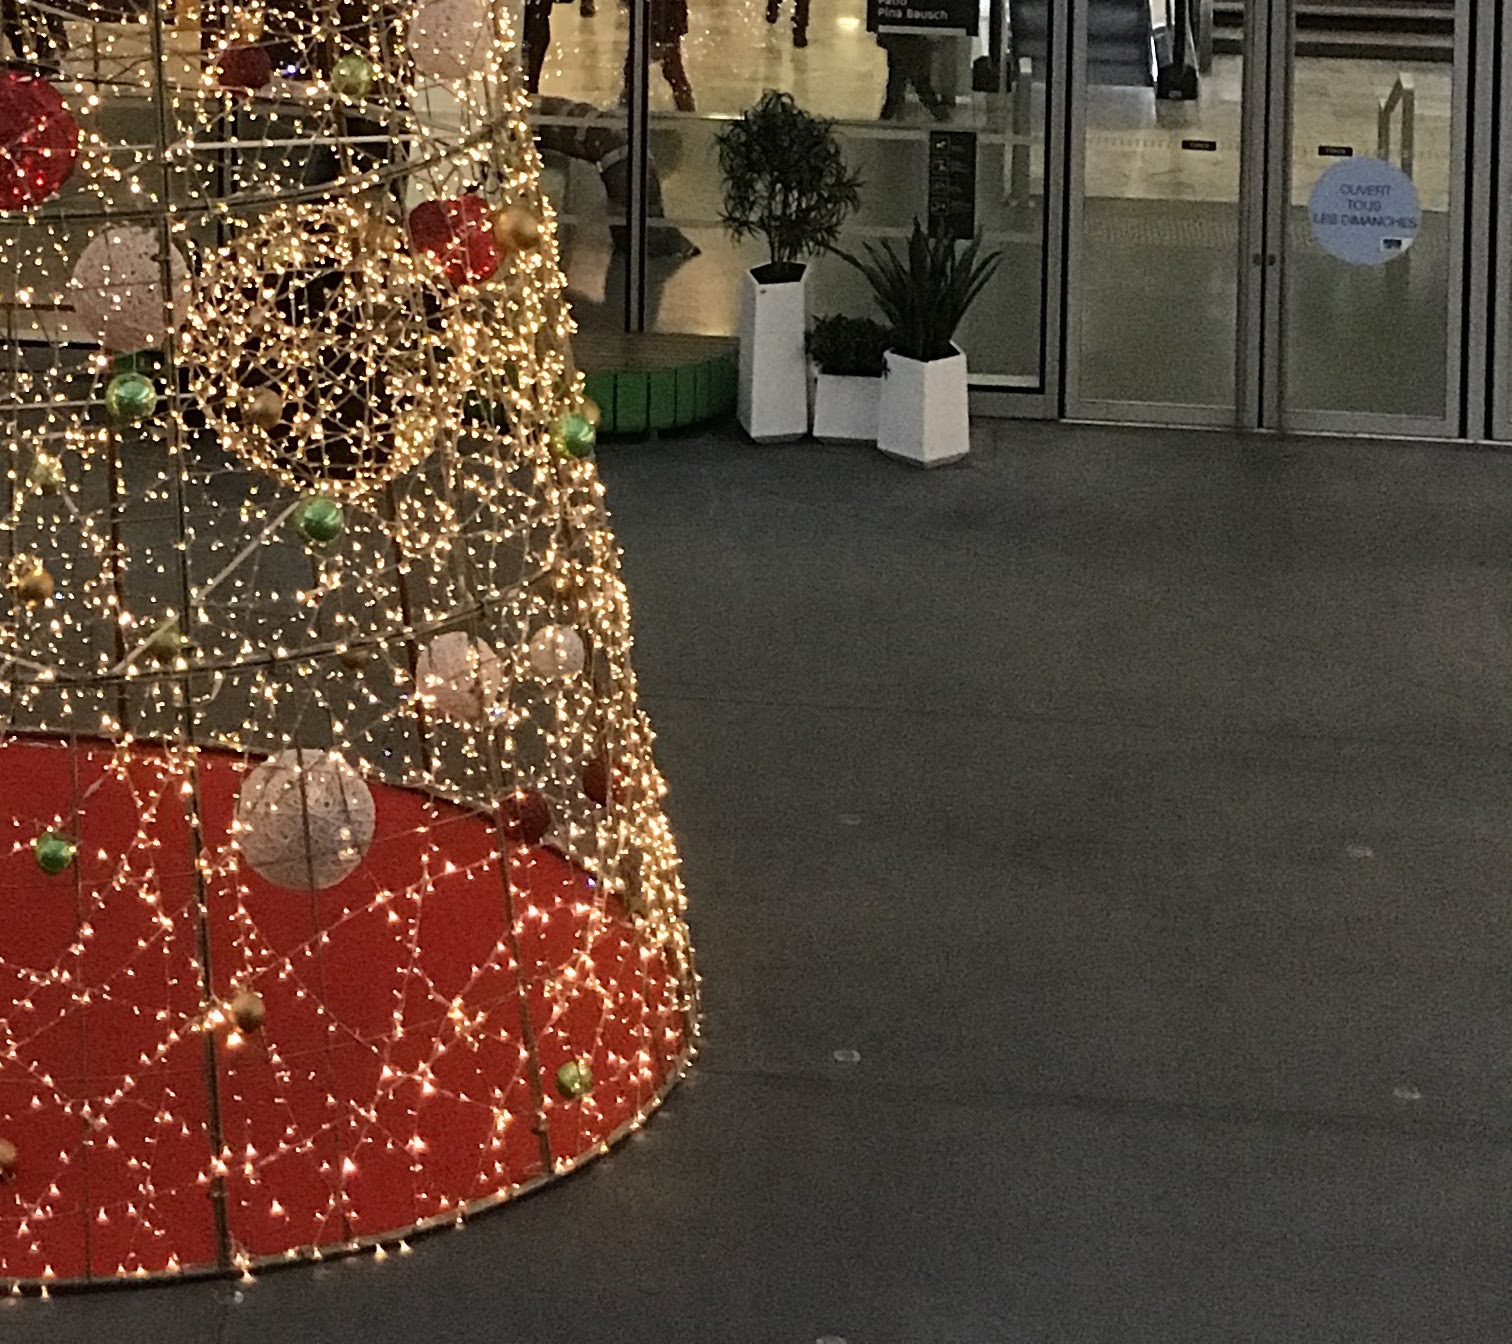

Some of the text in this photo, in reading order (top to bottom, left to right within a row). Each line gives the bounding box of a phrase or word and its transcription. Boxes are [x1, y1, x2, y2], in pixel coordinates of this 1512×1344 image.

[877, 7, 949, 21] Pina Bausch
[1339, 183, 1392, 196] OUVERT
[1348, 198, 1382, 212] TOUS
